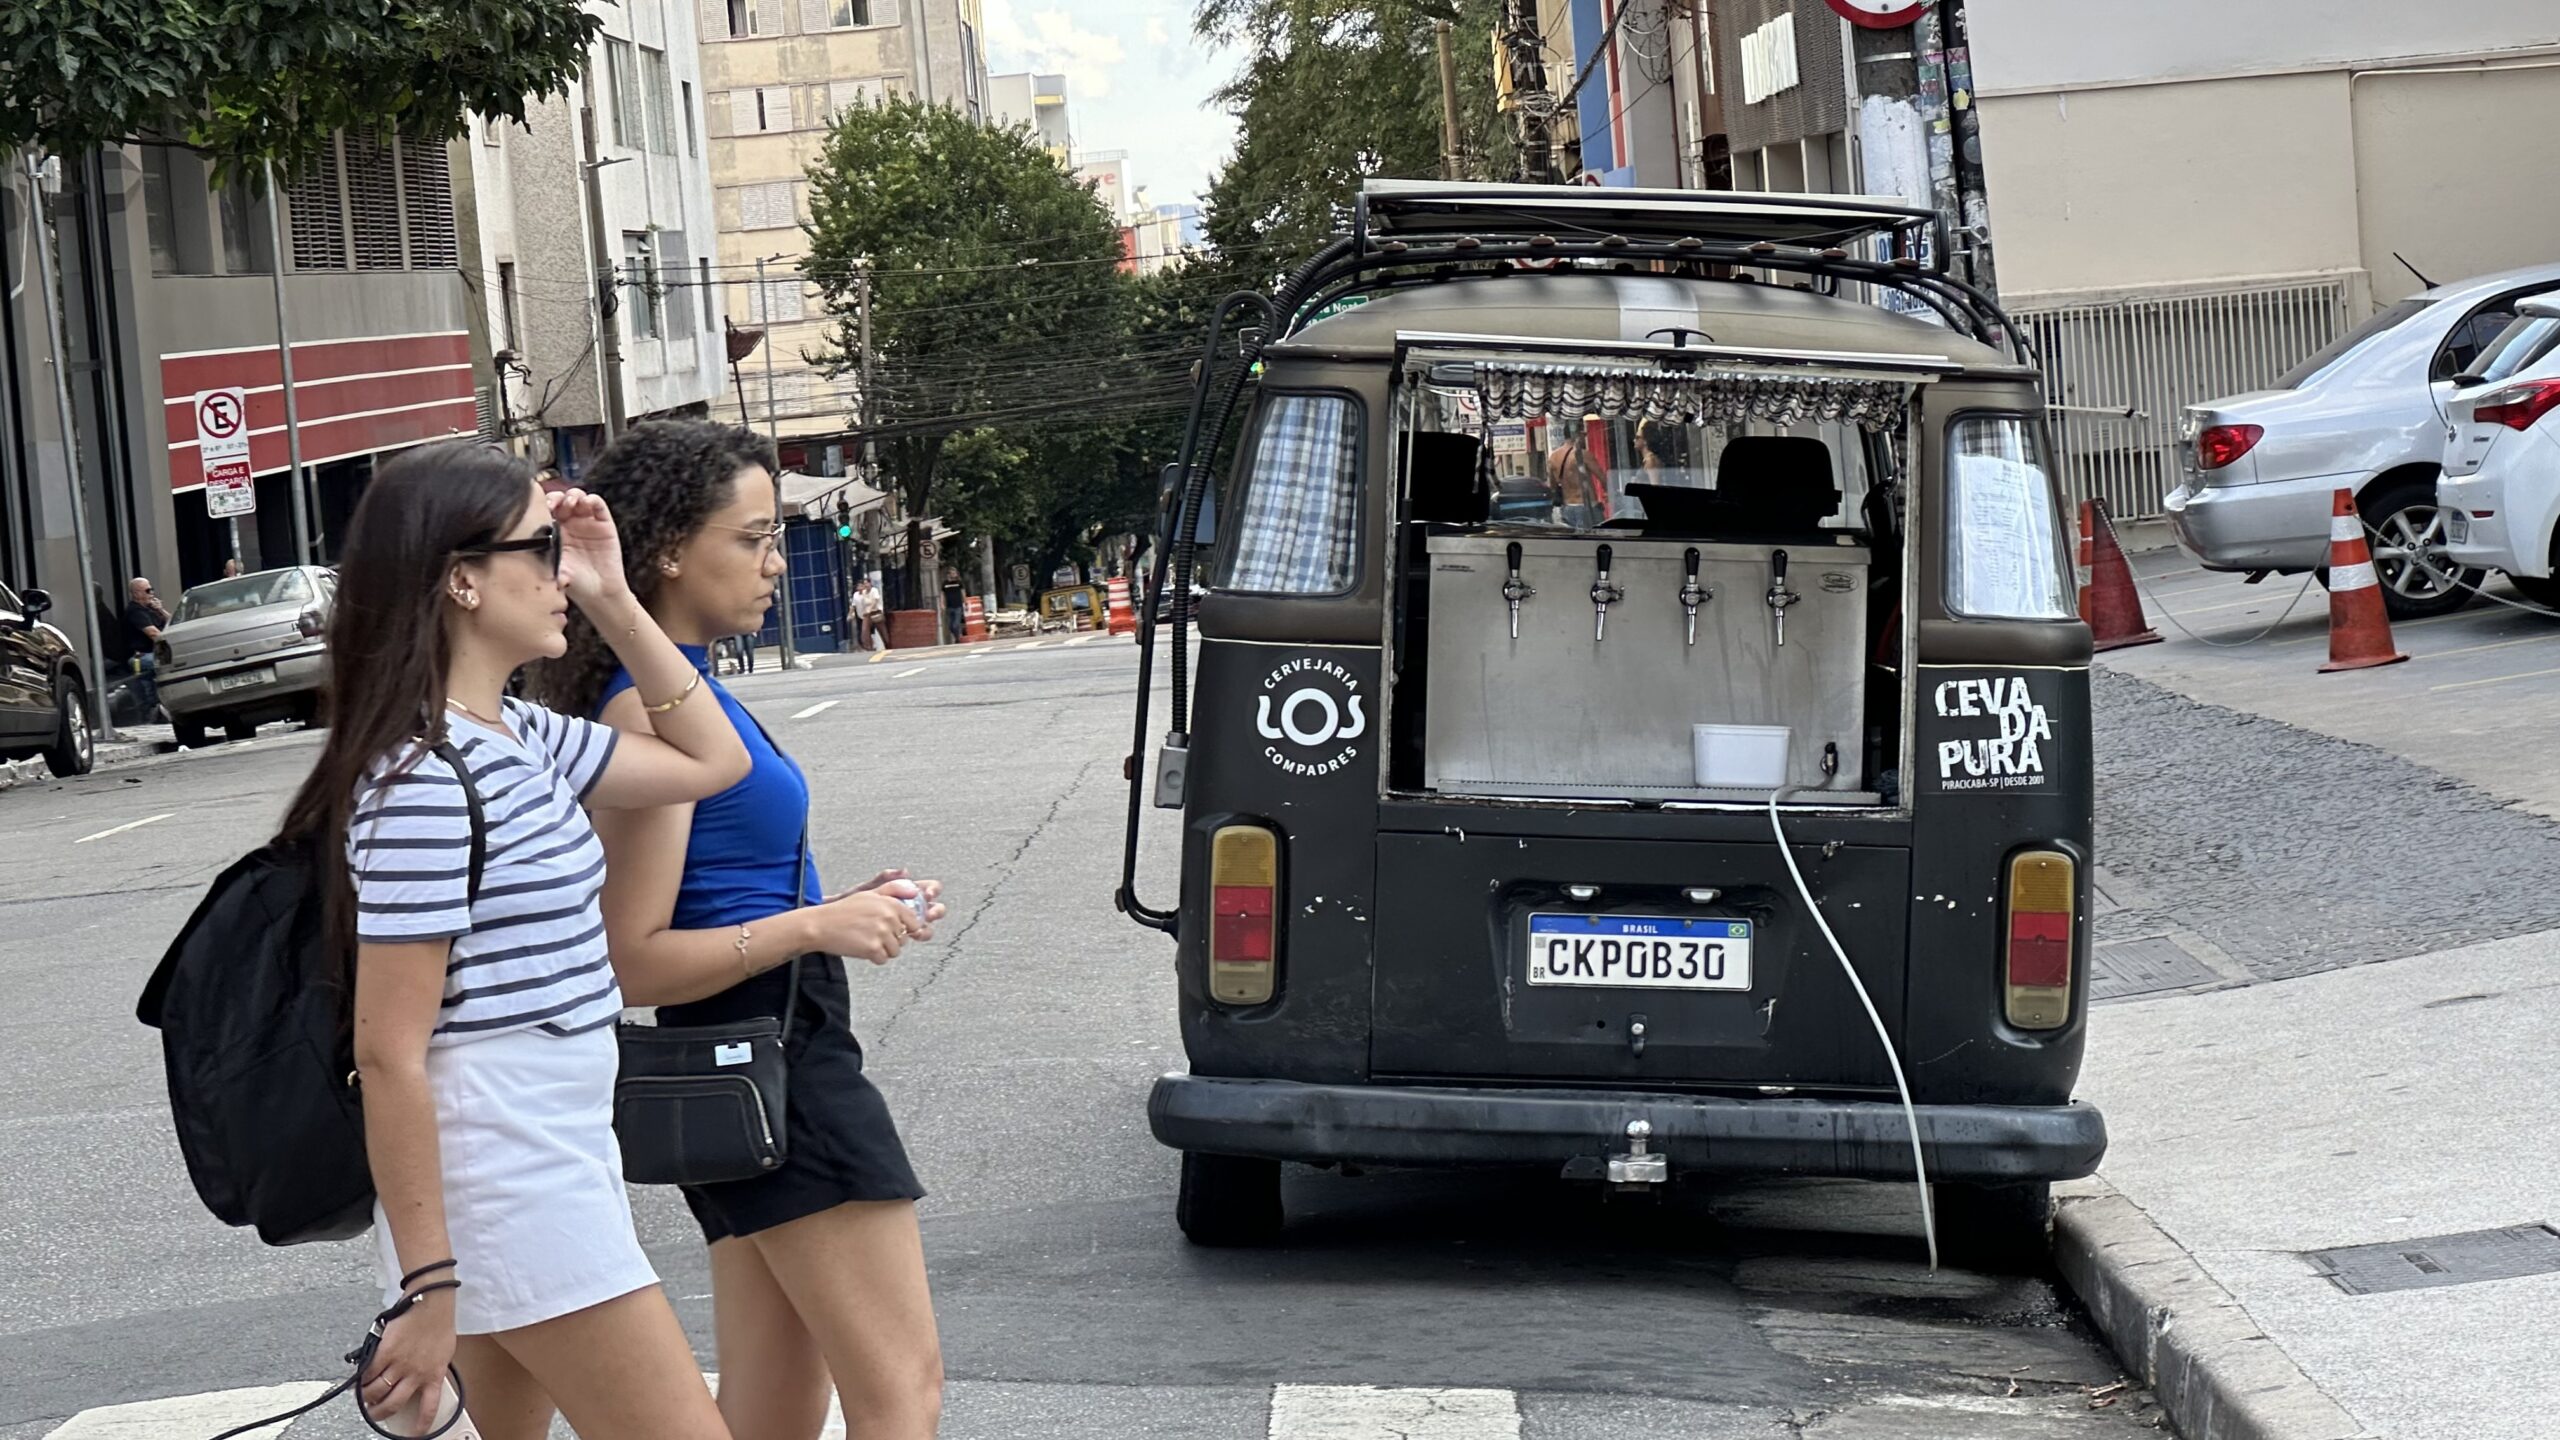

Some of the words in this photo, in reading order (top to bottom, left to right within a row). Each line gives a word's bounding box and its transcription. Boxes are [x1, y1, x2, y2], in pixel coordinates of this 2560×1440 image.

[1264, 658, 1358, 691] CERVEJARIA
[1934, 676, 2033, 717] CEVA
[1256, 687, 1366, 746] LOS
[1999, 704, 2052, 742] DA
[1264, 746, 1357, 776] COMPADRES
[1938, 737, 2043, 778] PURA
[1942, 778, 1999, 790] PIRACICABA-SP
[2004, 776, 2028, 787] DESDE
[2028, 775, 2044, 785] 2001
[1622, 924, 1659, 934] BRASIL
[1533, 966, 1546, 979] BR
[1548, 938, 1725, 981] CKP0B30
